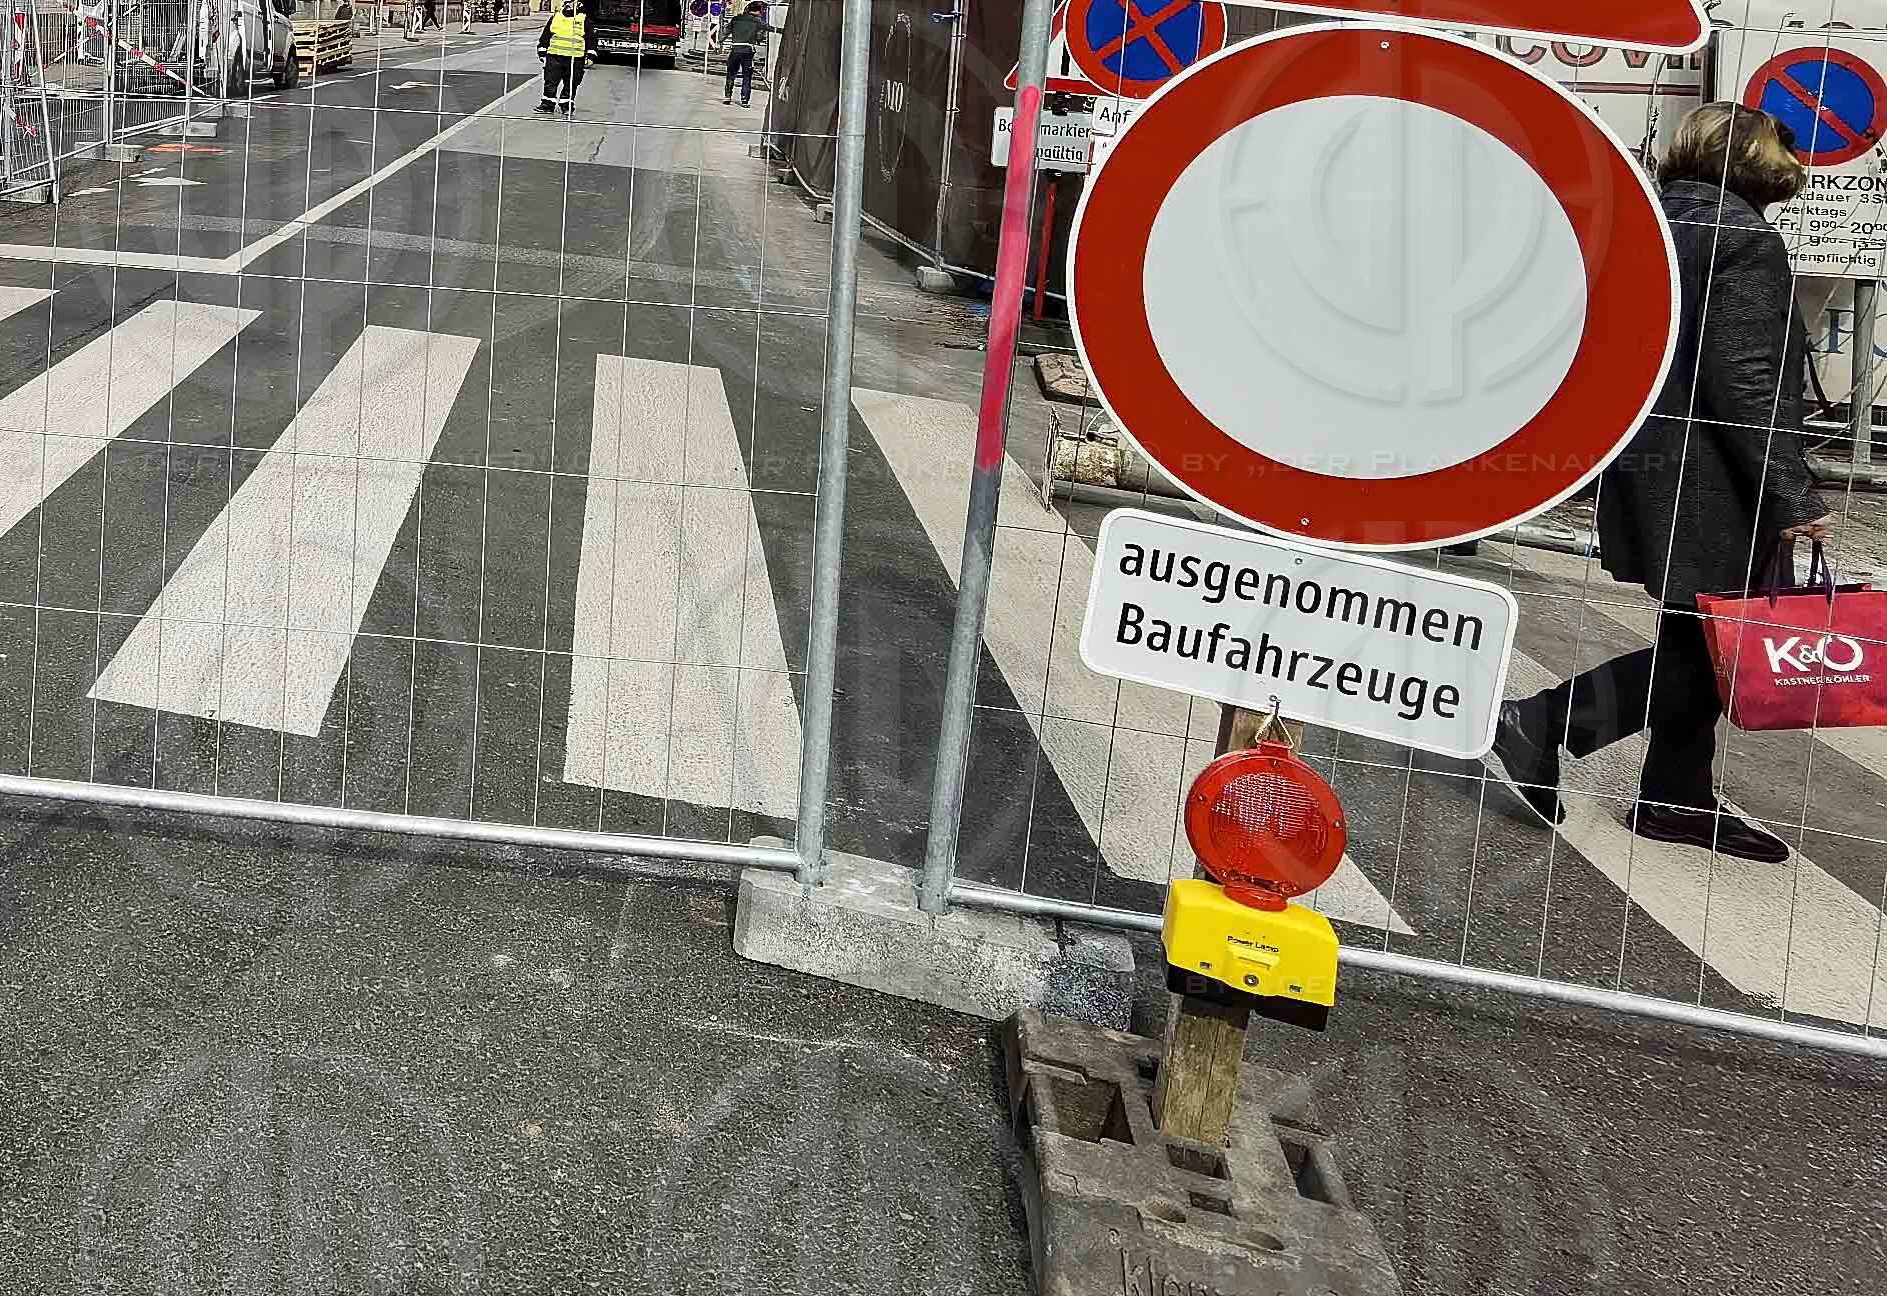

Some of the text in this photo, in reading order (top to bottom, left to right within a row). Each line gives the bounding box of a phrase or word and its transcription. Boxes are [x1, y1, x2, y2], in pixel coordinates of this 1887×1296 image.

[1035, 146, 1083, 162] ngültig
[1795, 191, 1852, 203] kdauer
[1779, 206, 1847, 218] werktags
[1118, 542, 1483, 652] ausgenommen
[1115, 602, 1461, 721] Baufahrzeuge
[1227, 935, 1280, 954] Power Lamp
